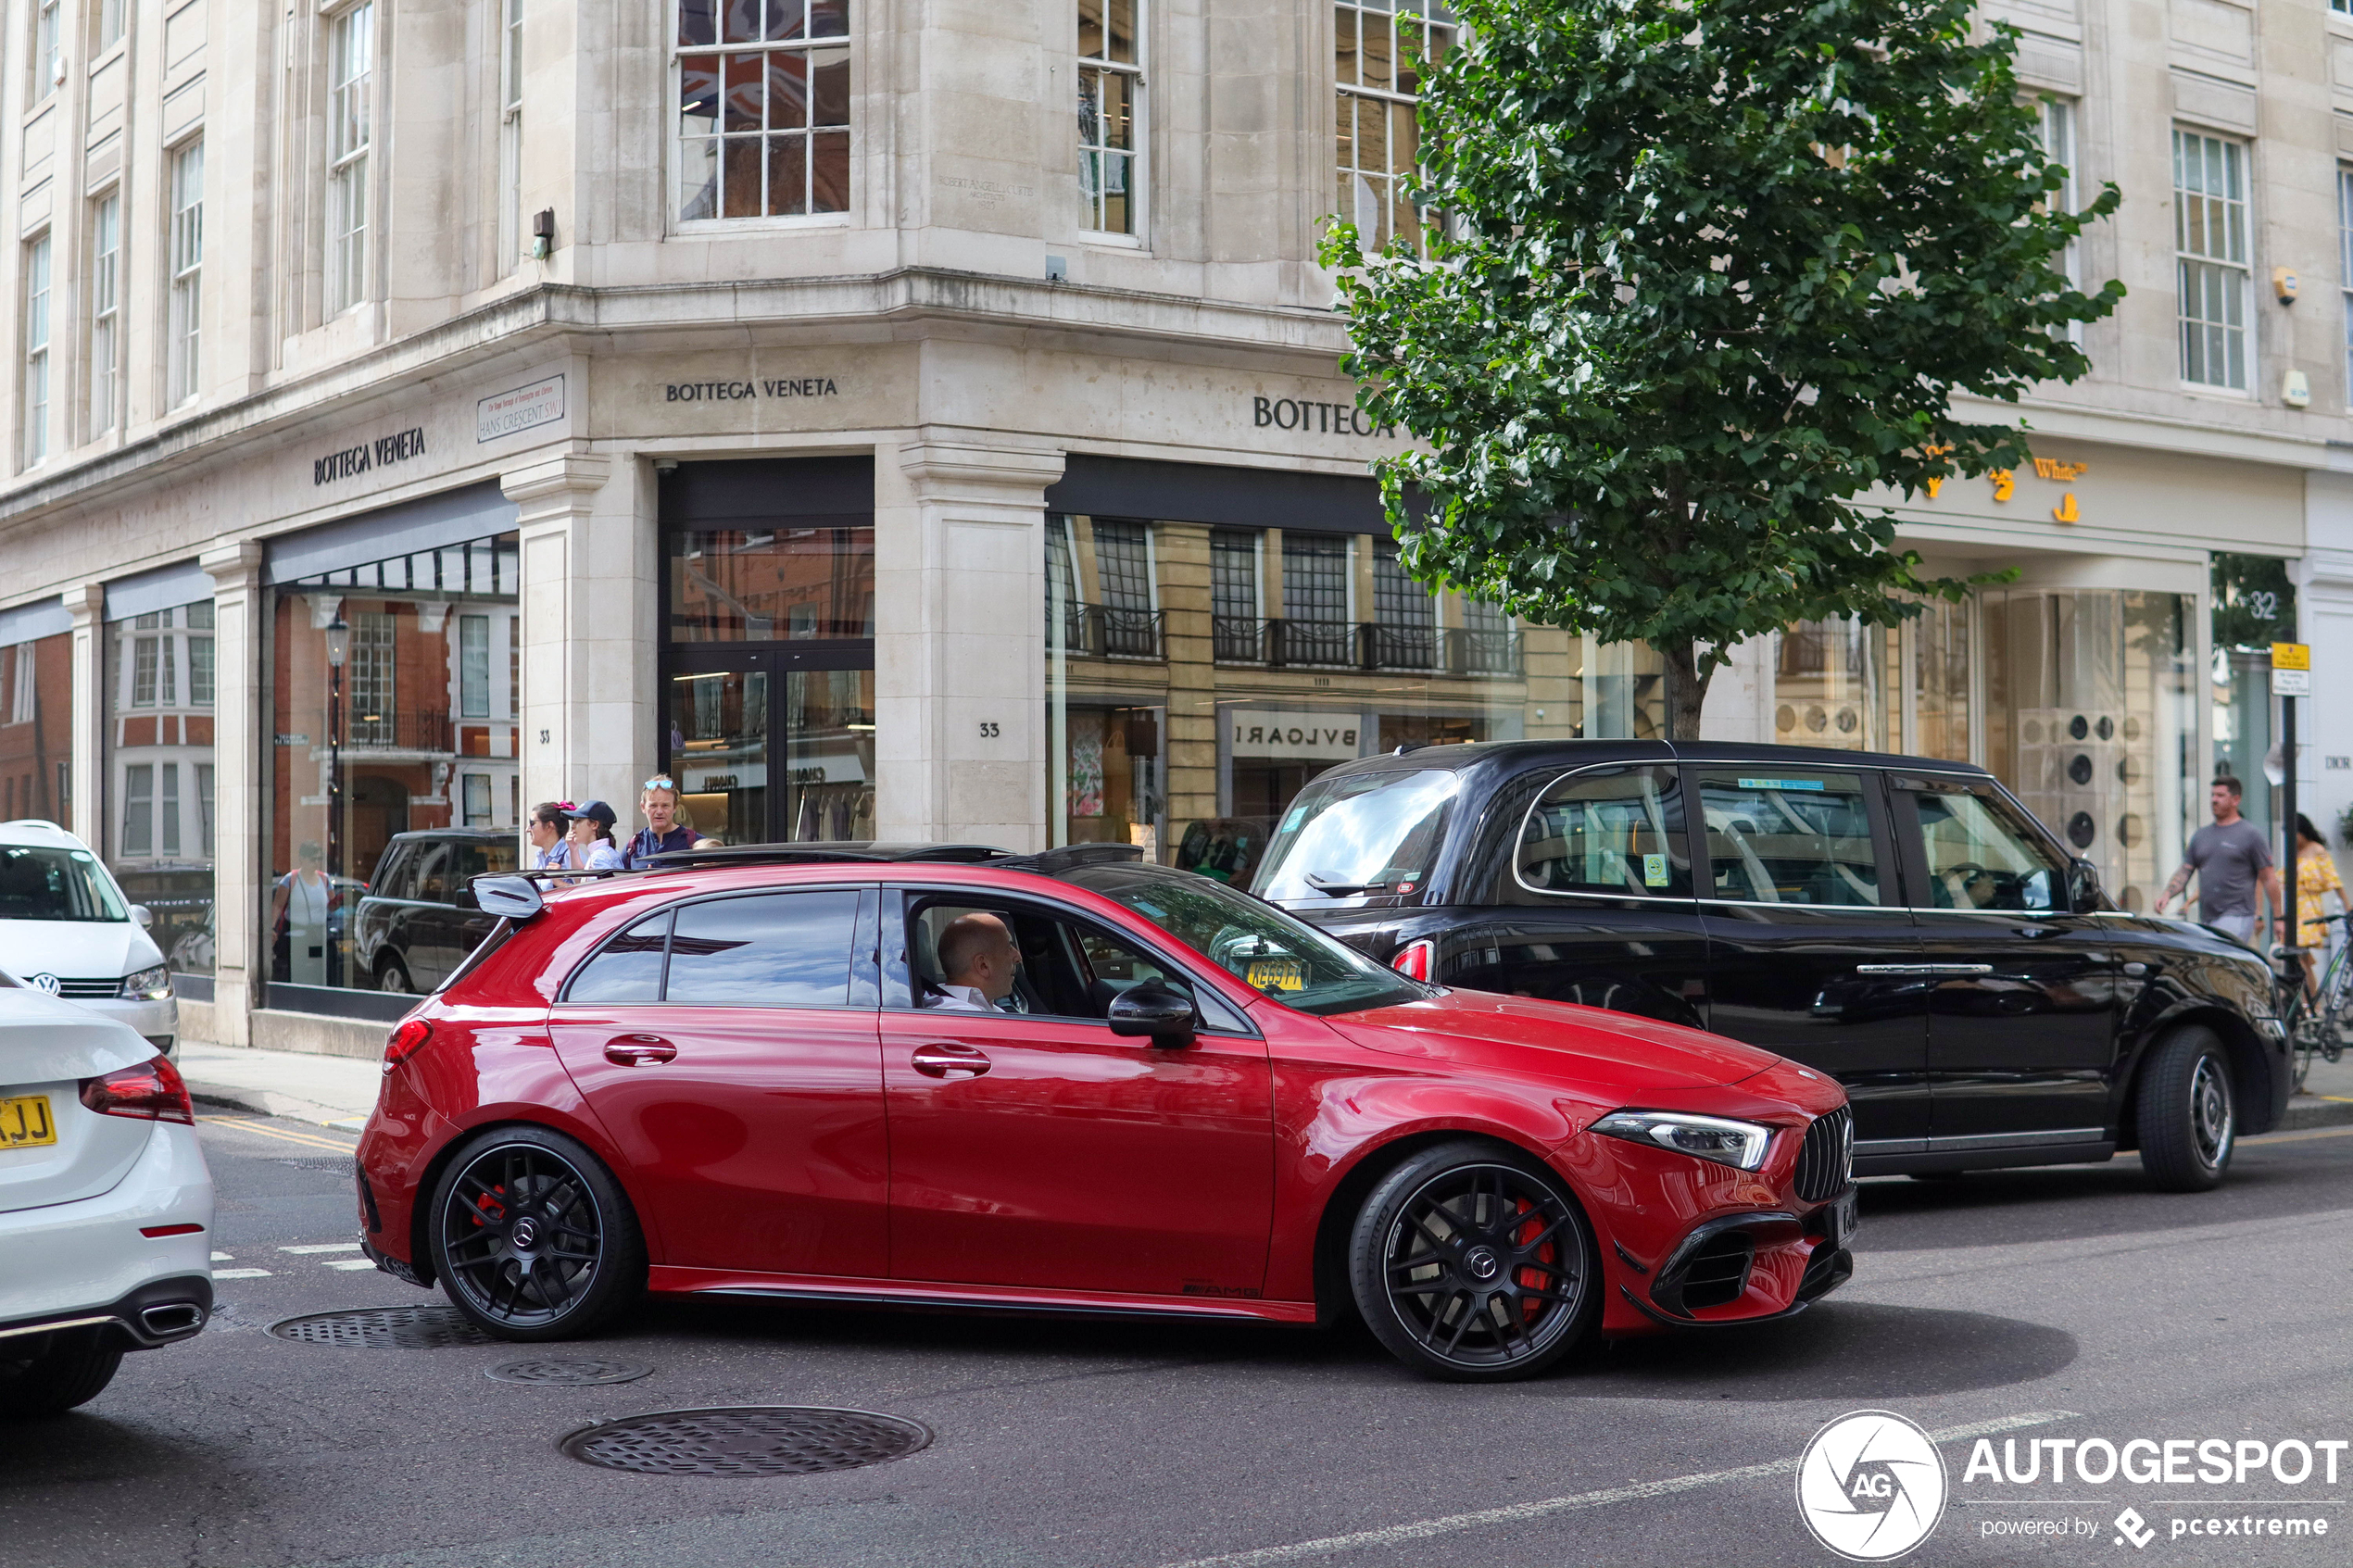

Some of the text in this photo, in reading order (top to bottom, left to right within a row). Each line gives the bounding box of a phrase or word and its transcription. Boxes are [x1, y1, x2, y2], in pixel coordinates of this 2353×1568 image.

[666, 377, 838, 402] BOTTEGA VENETA
[479, 416, 501, 439] HANS
[315, 426, 425, 485] BOTTEGA VENETA
[2250, 590, 2277, 620] 32
[539, 729, 550, 744] 33
[980, 722, 1000, 737] 33
[2325, 755, 2350, 770] DIOR
[0, 1102, 48, 1141] JJ
[1204, 1286, 1260, 1297] AMG
